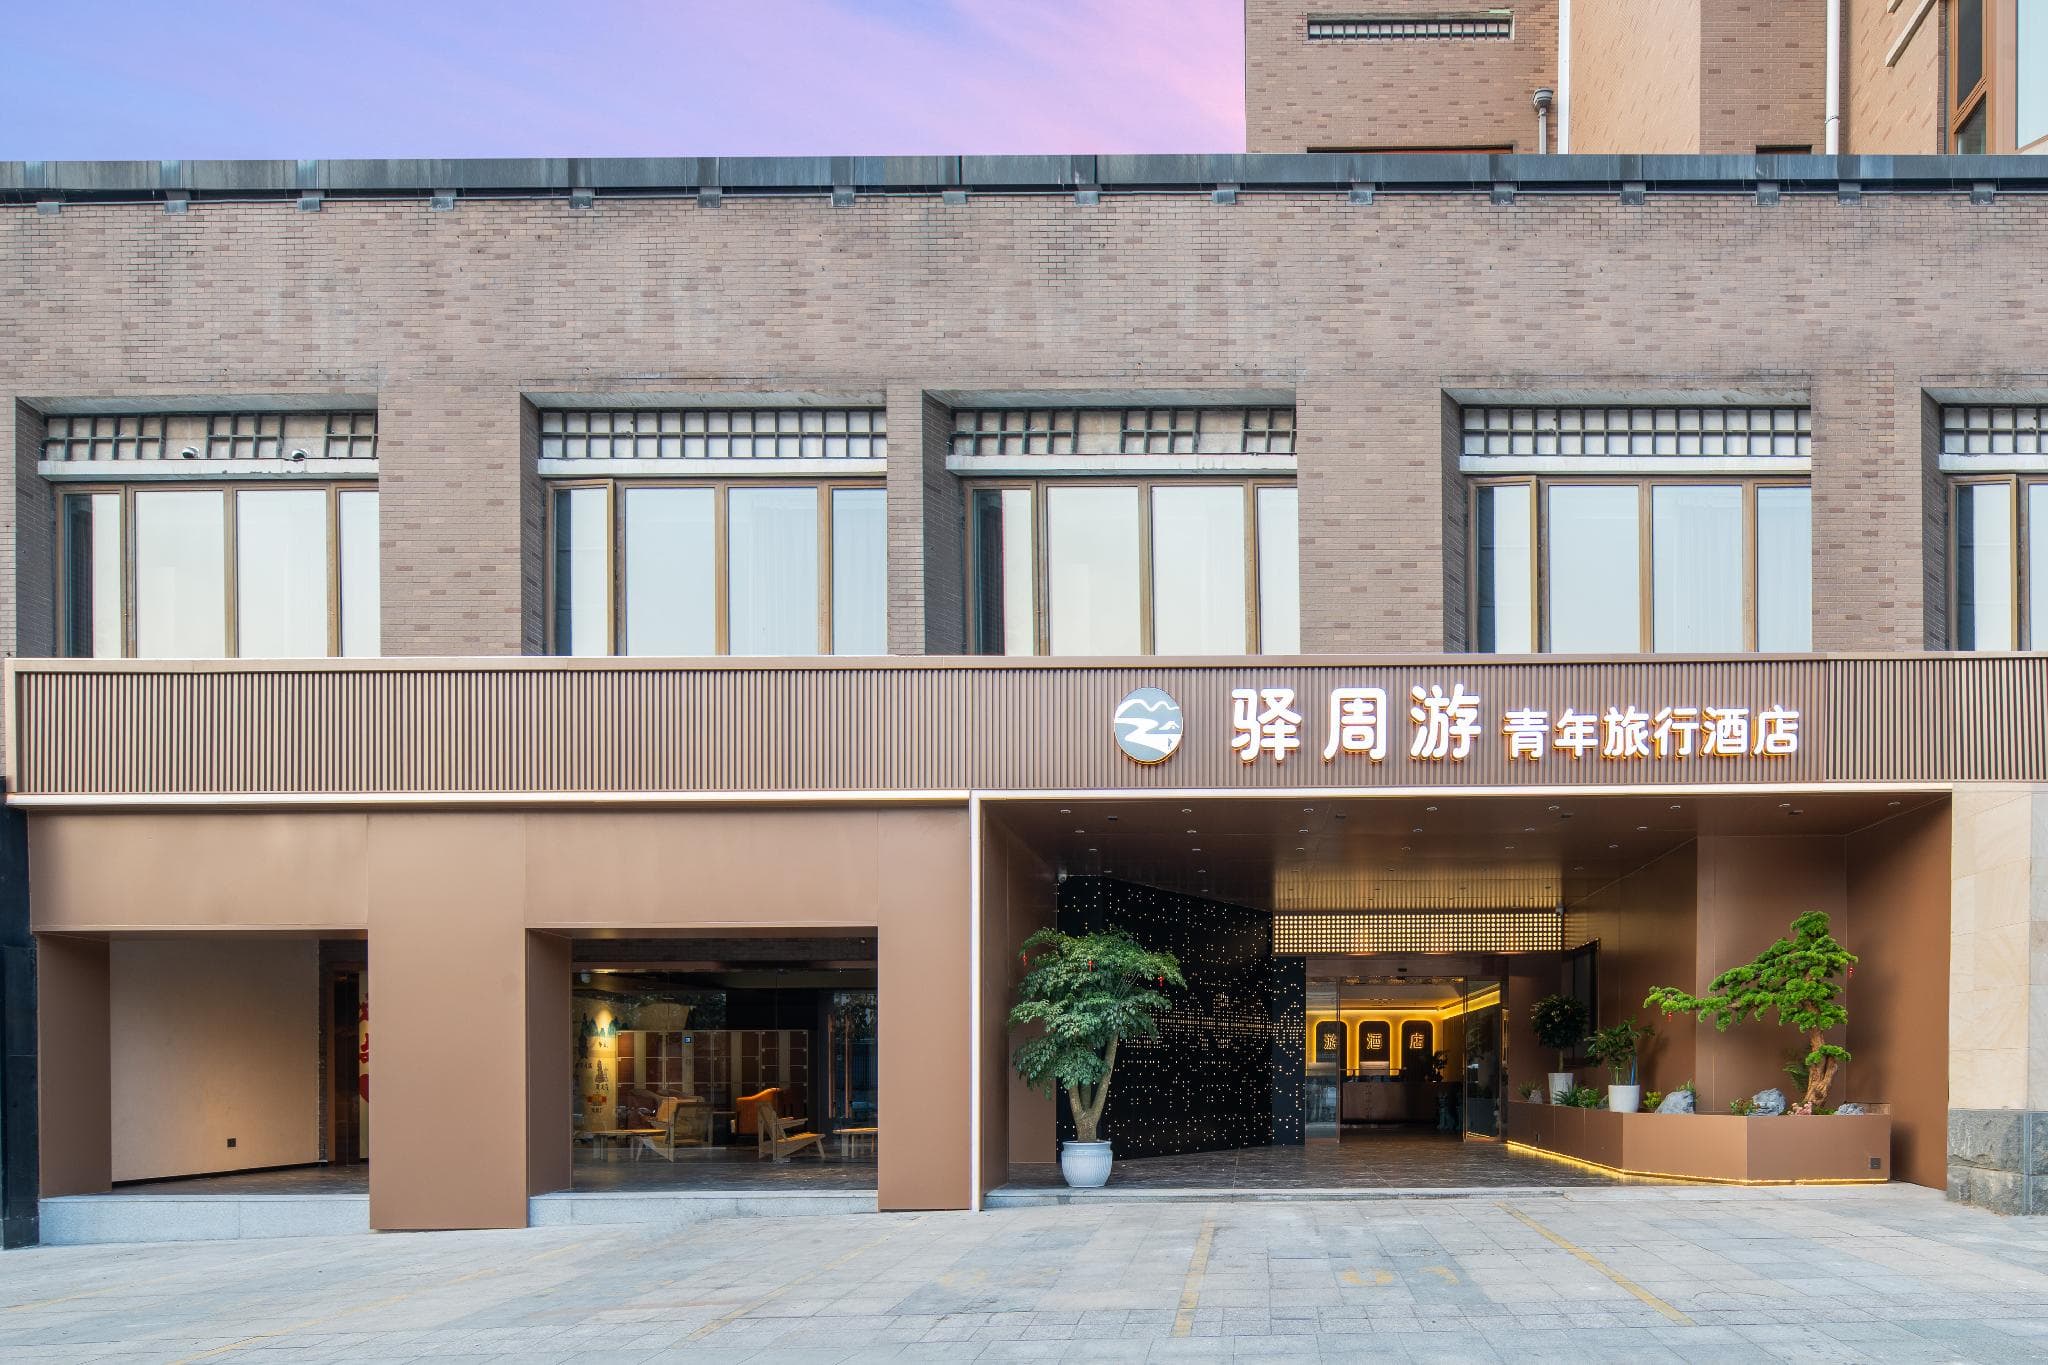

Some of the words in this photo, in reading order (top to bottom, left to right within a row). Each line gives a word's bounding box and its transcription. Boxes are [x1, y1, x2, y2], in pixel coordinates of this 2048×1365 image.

[1230, 683, 1482, 761] 驿周游
[1503, 704, 1800, 759] 青年旅行酒店
